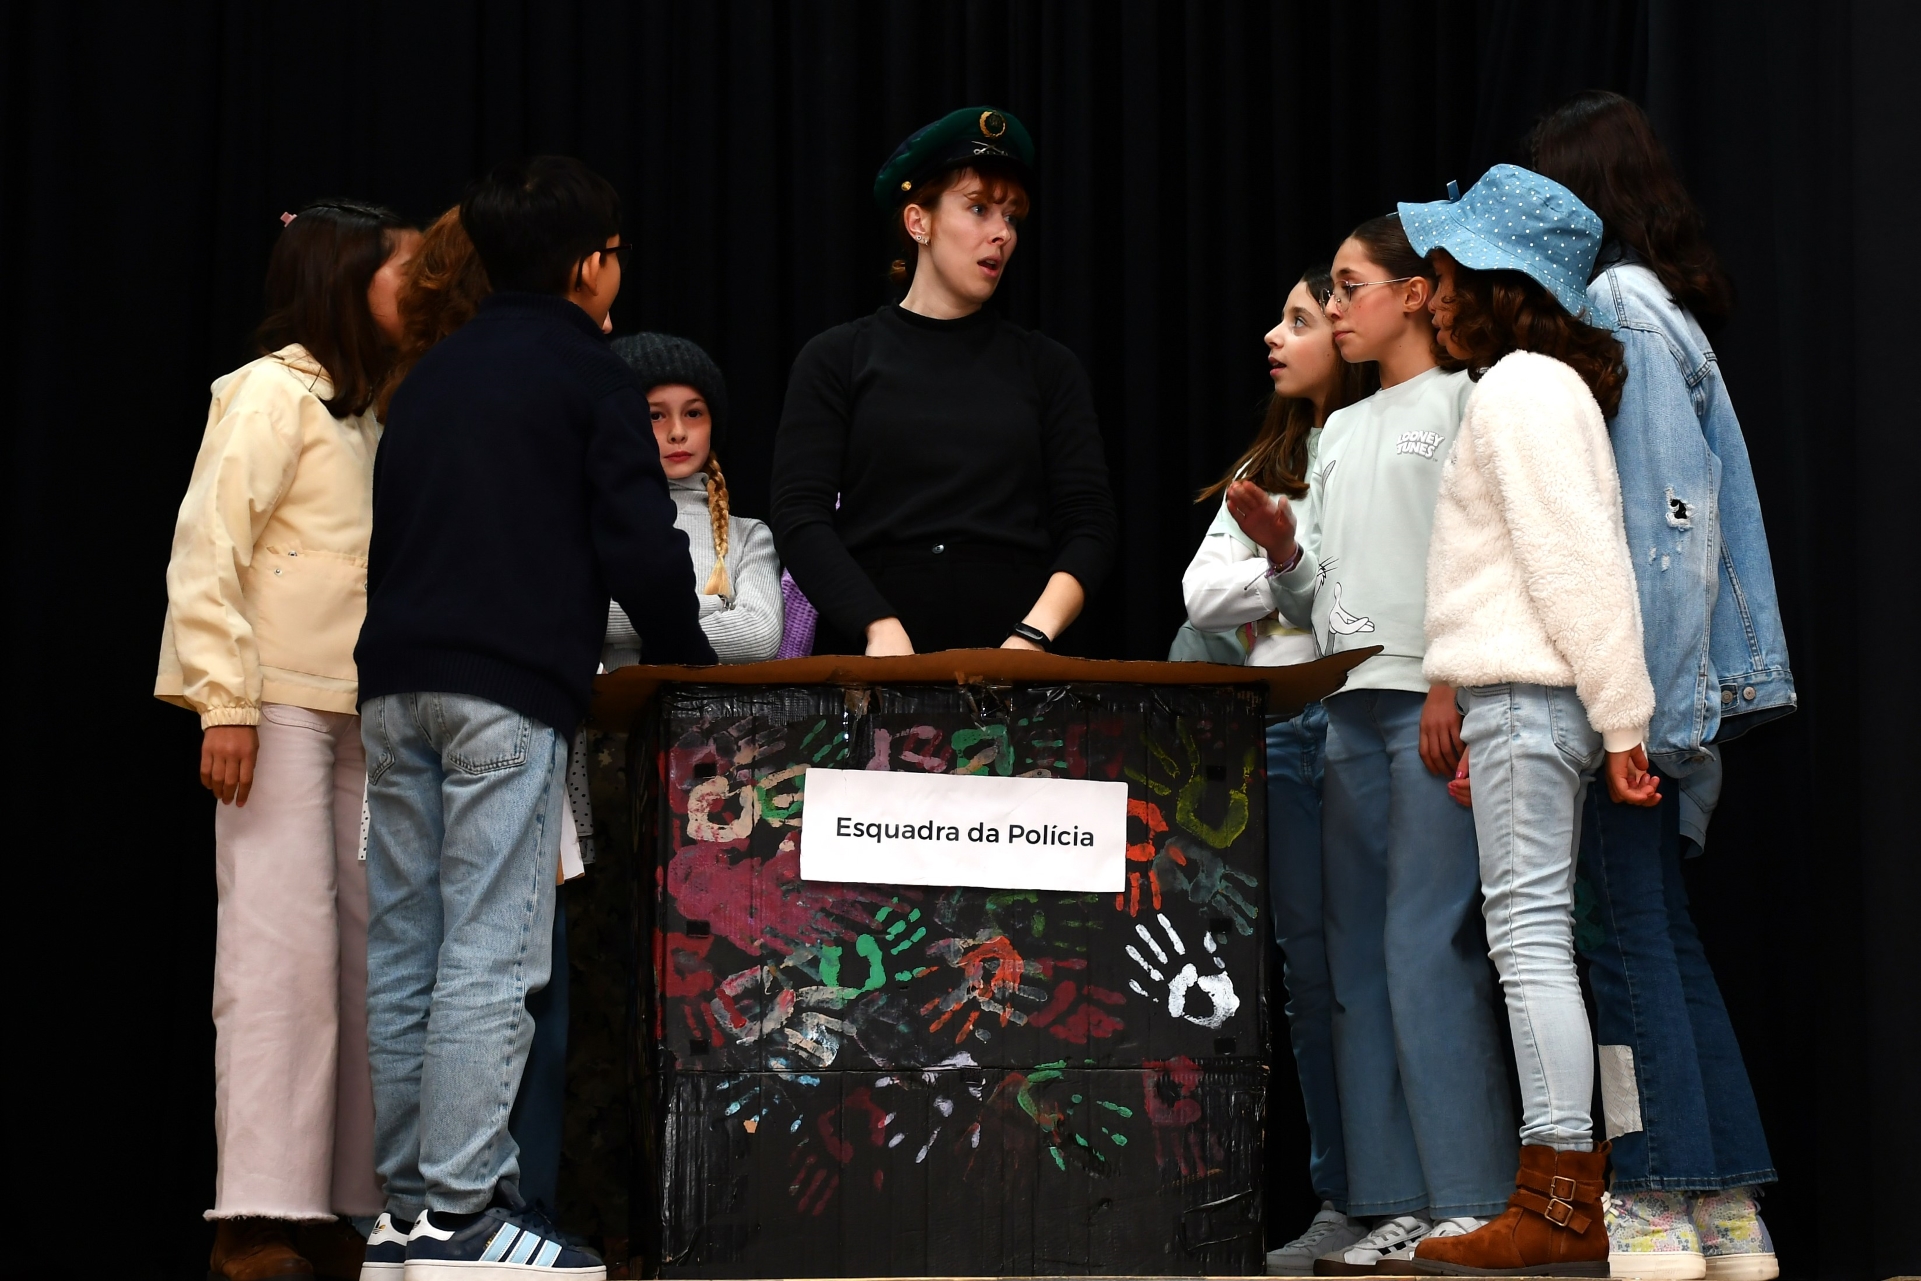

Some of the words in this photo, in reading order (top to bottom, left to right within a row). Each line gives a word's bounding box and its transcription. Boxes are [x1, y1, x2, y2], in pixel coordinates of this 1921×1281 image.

[1396, 430, 1445, 448] LOONEY
[1396, 441, 1435, 459] TUNES
[836, 816, 960, 844] Esquadra
[967, 821, 1000, 844] da
[1008, 824, 1095, 847] Polícia
